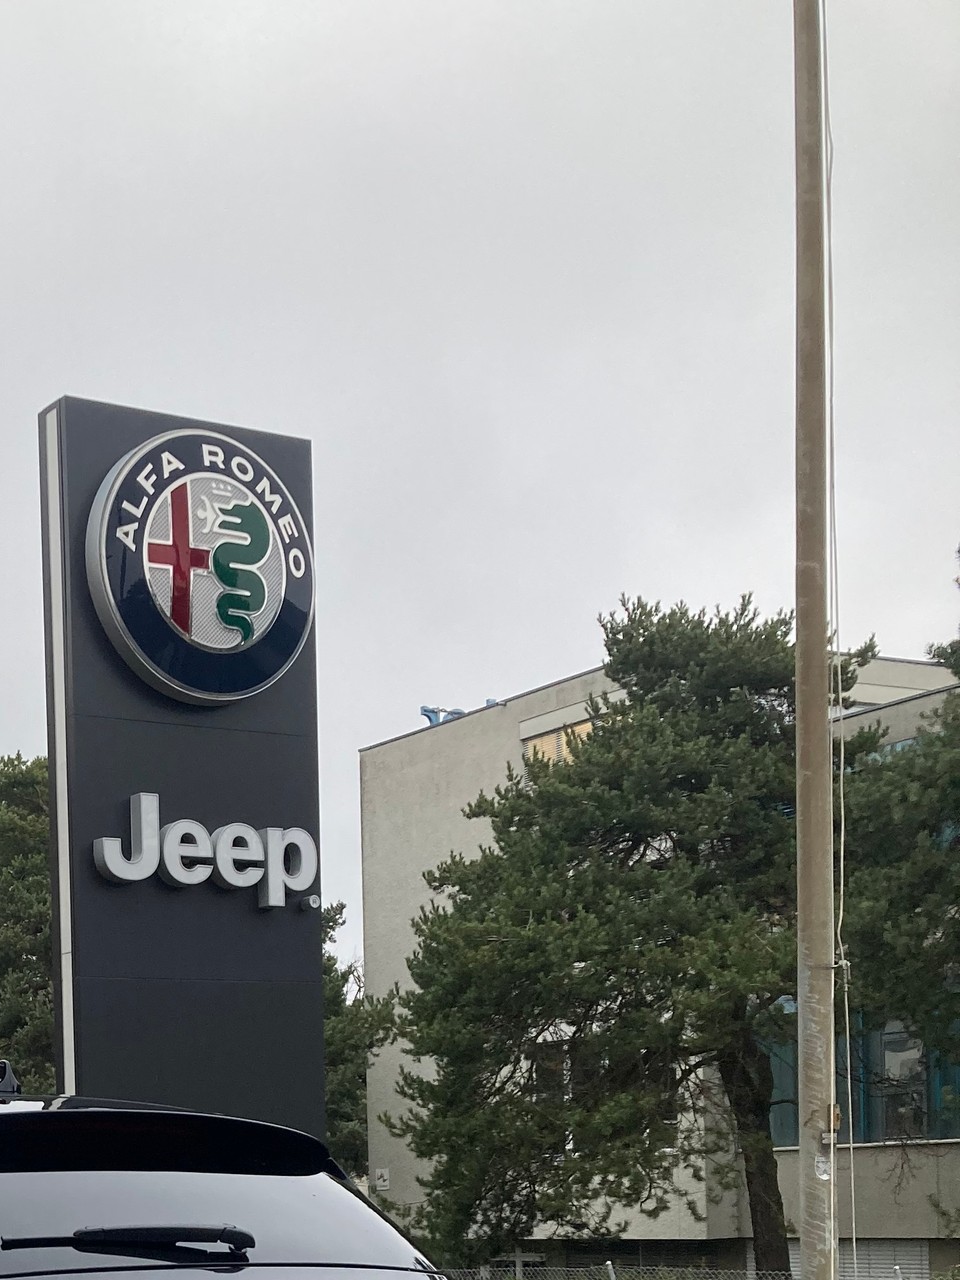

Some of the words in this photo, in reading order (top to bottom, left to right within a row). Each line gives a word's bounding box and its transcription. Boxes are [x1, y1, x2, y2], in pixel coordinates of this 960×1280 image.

[115, 449, 186, 552] ALFA
[201, 443, 307, 580] ROMEO
[93, 792, 318, 908] Jeep
